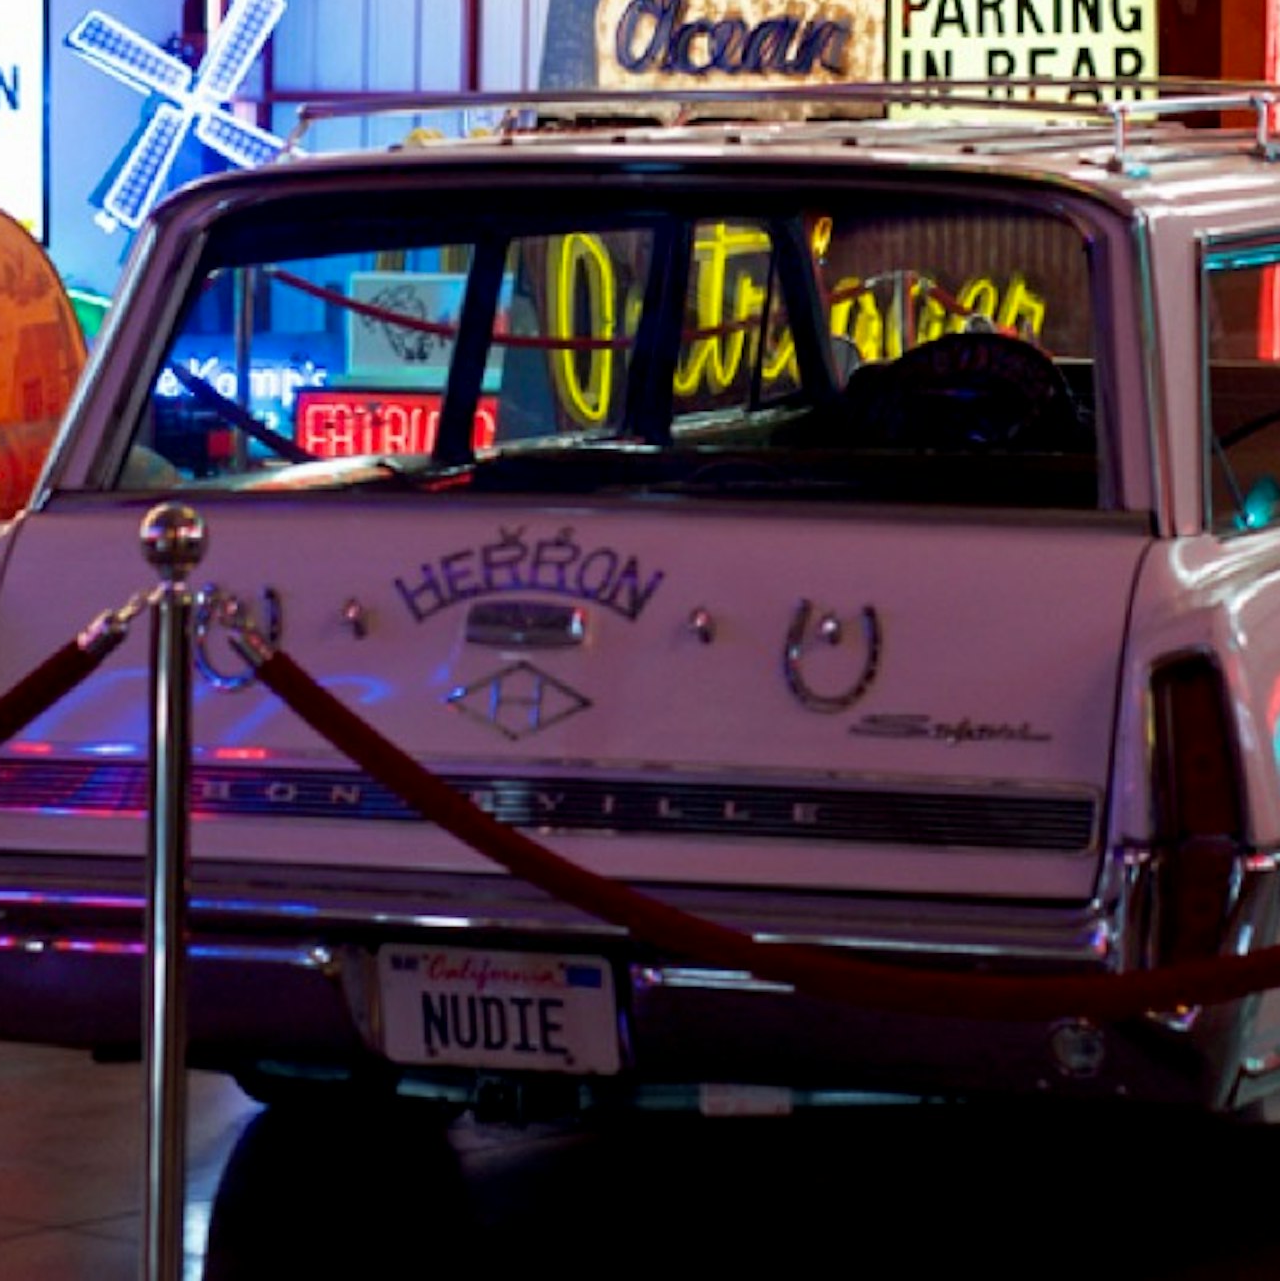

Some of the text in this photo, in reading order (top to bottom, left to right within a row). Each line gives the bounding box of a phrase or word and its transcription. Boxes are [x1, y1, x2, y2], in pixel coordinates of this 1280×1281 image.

[901, 47, 1145, 109] IN REAR
[394, 536, 665, 623] HERRON
[427, 952, 558, 990] California
[421, 991, 568, 1055] NUDIE
